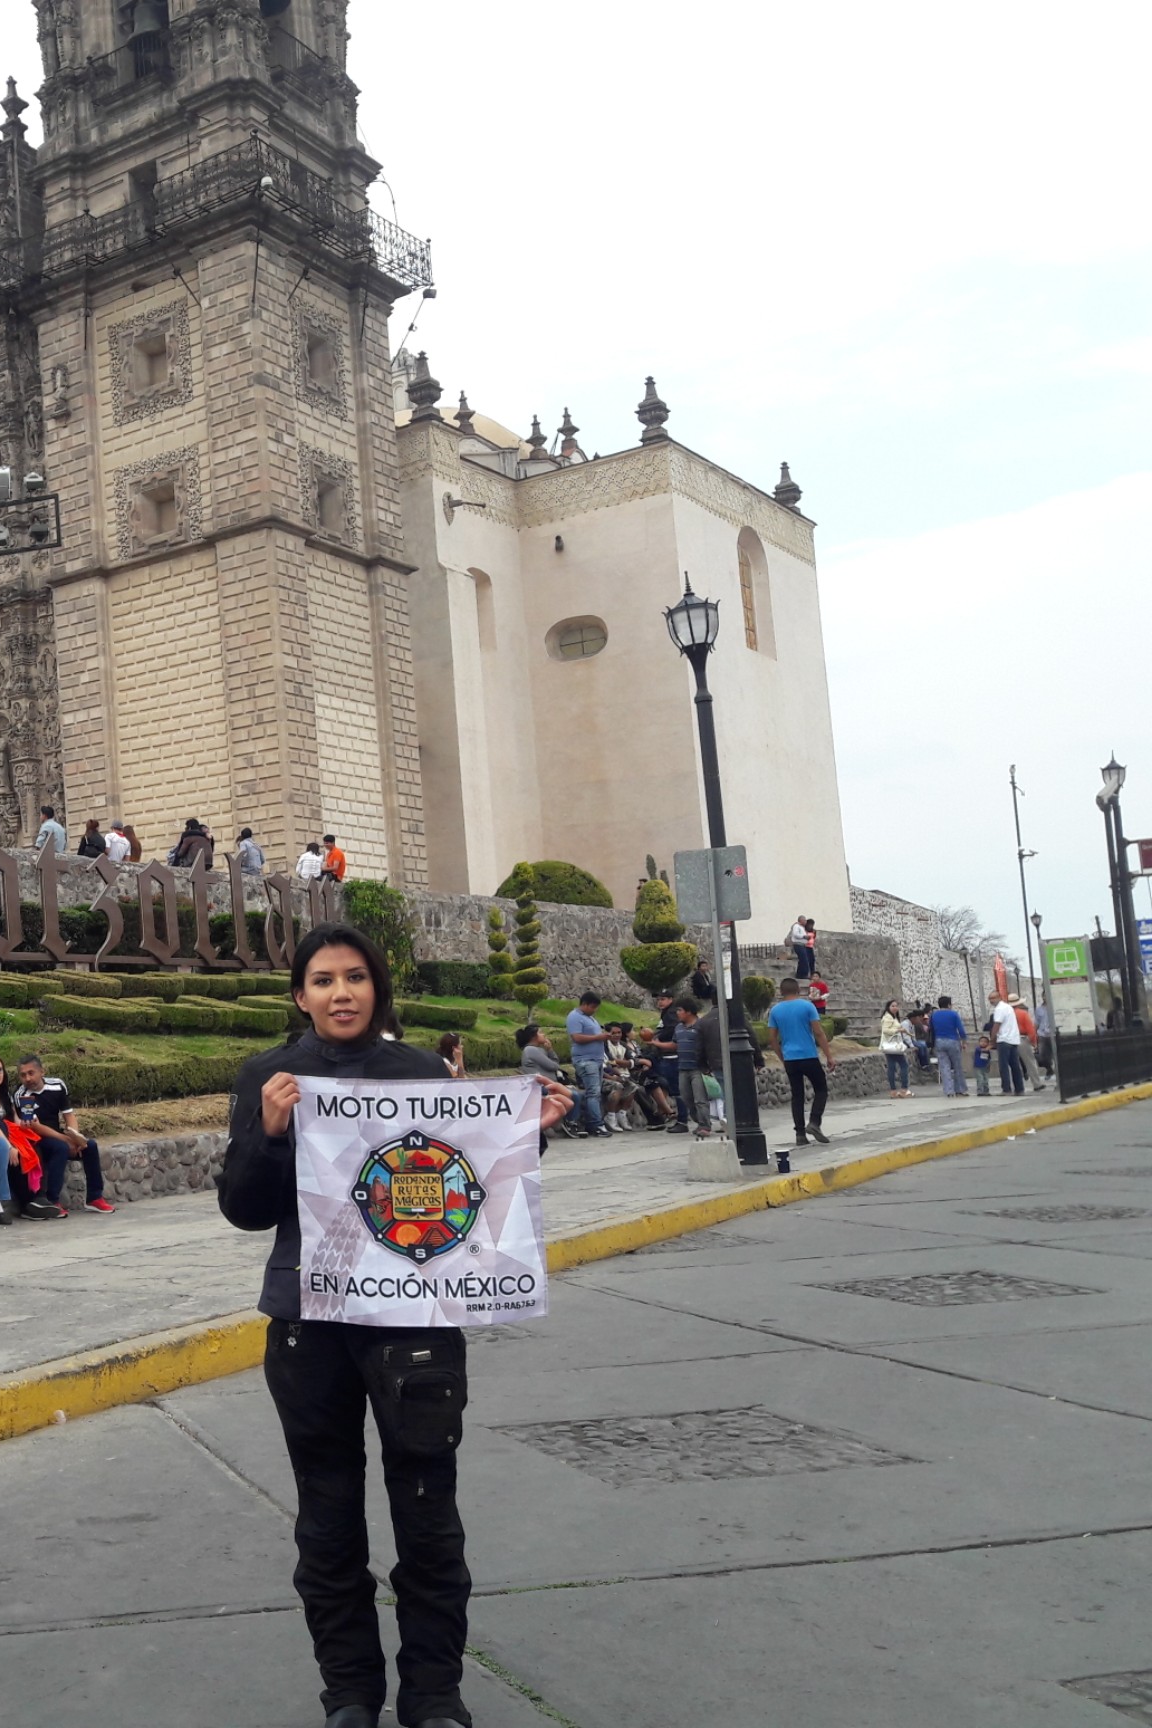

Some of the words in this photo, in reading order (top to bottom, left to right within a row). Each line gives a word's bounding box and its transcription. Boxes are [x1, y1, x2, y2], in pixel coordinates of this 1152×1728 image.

[317, 1094, 399, 1119] MOTO
[406, 1094, 512, 1119] TURISTA
[409, 1136, 423, 1146] N
[470, 1191, 481, 1200] E
[415, 1248, 426, 1258] S
[310, 1272, 339, 1295] EN
[345, 1272, 438, 1298] ACCIÓN
[444, 1271, 536, 1299] MÉXICO
[466, 1303, 486, 1312] RRM
